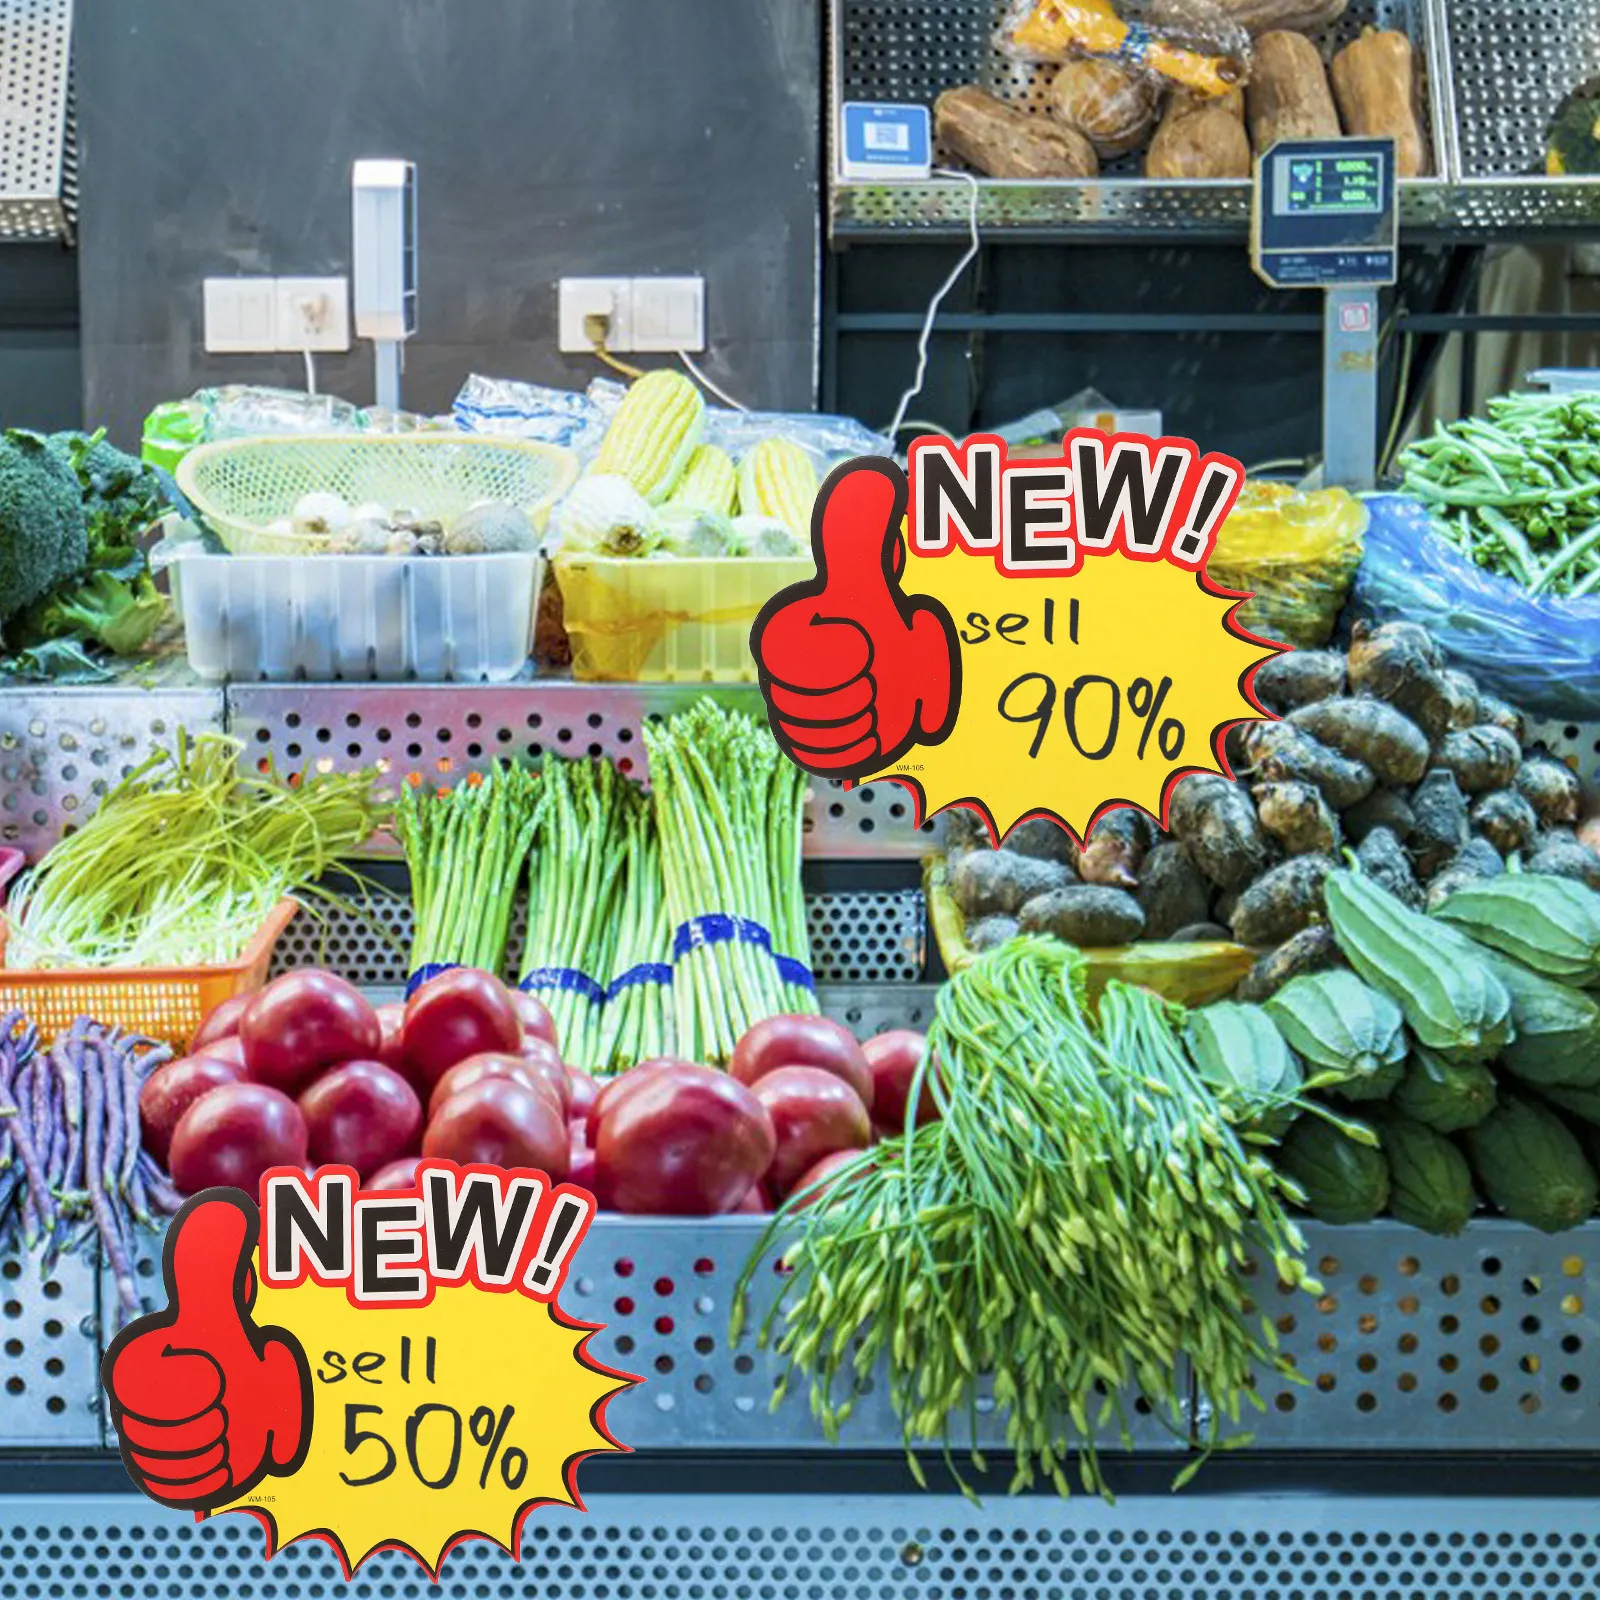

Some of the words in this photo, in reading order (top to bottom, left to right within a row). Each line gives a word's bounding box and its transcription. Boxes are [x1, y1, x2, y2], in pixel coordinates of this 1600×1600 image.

[922, 444, 1230, 563] NEW!
[960, 597, 1080, 646] sell
[997, 672, 1186, 761] 90%
[896, 764, 925, 772] WM-105
[274, 1175, 582, 1294] NEW!
[316, 1335, 437, 1385] sell
[338, 1403, 529, 1491] 50%
[247, 1495, 276, 1503] WM-105
